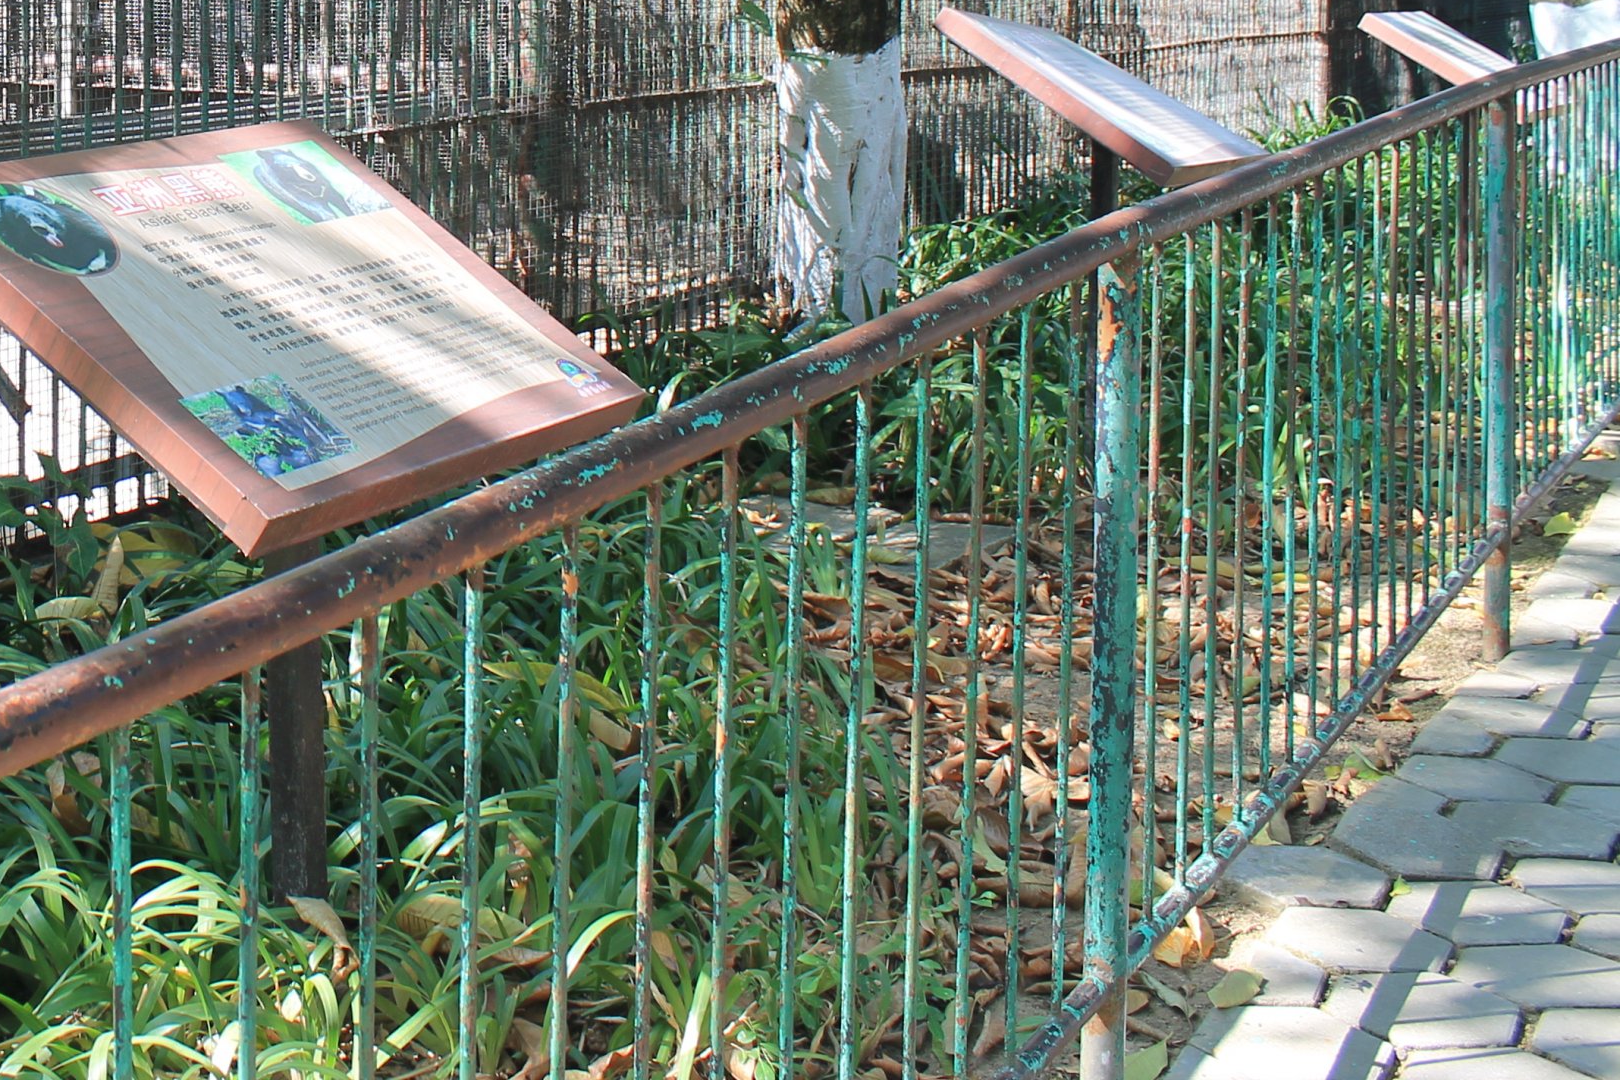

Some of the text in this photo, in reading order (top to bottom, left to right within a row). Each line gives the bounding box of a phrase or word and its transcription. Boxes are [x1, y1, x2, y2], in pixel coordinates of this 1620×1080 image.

[90, 169, 245, 217] 亚洲黑熊
[138, 200, 254, 229] Asiatic Black Bear
